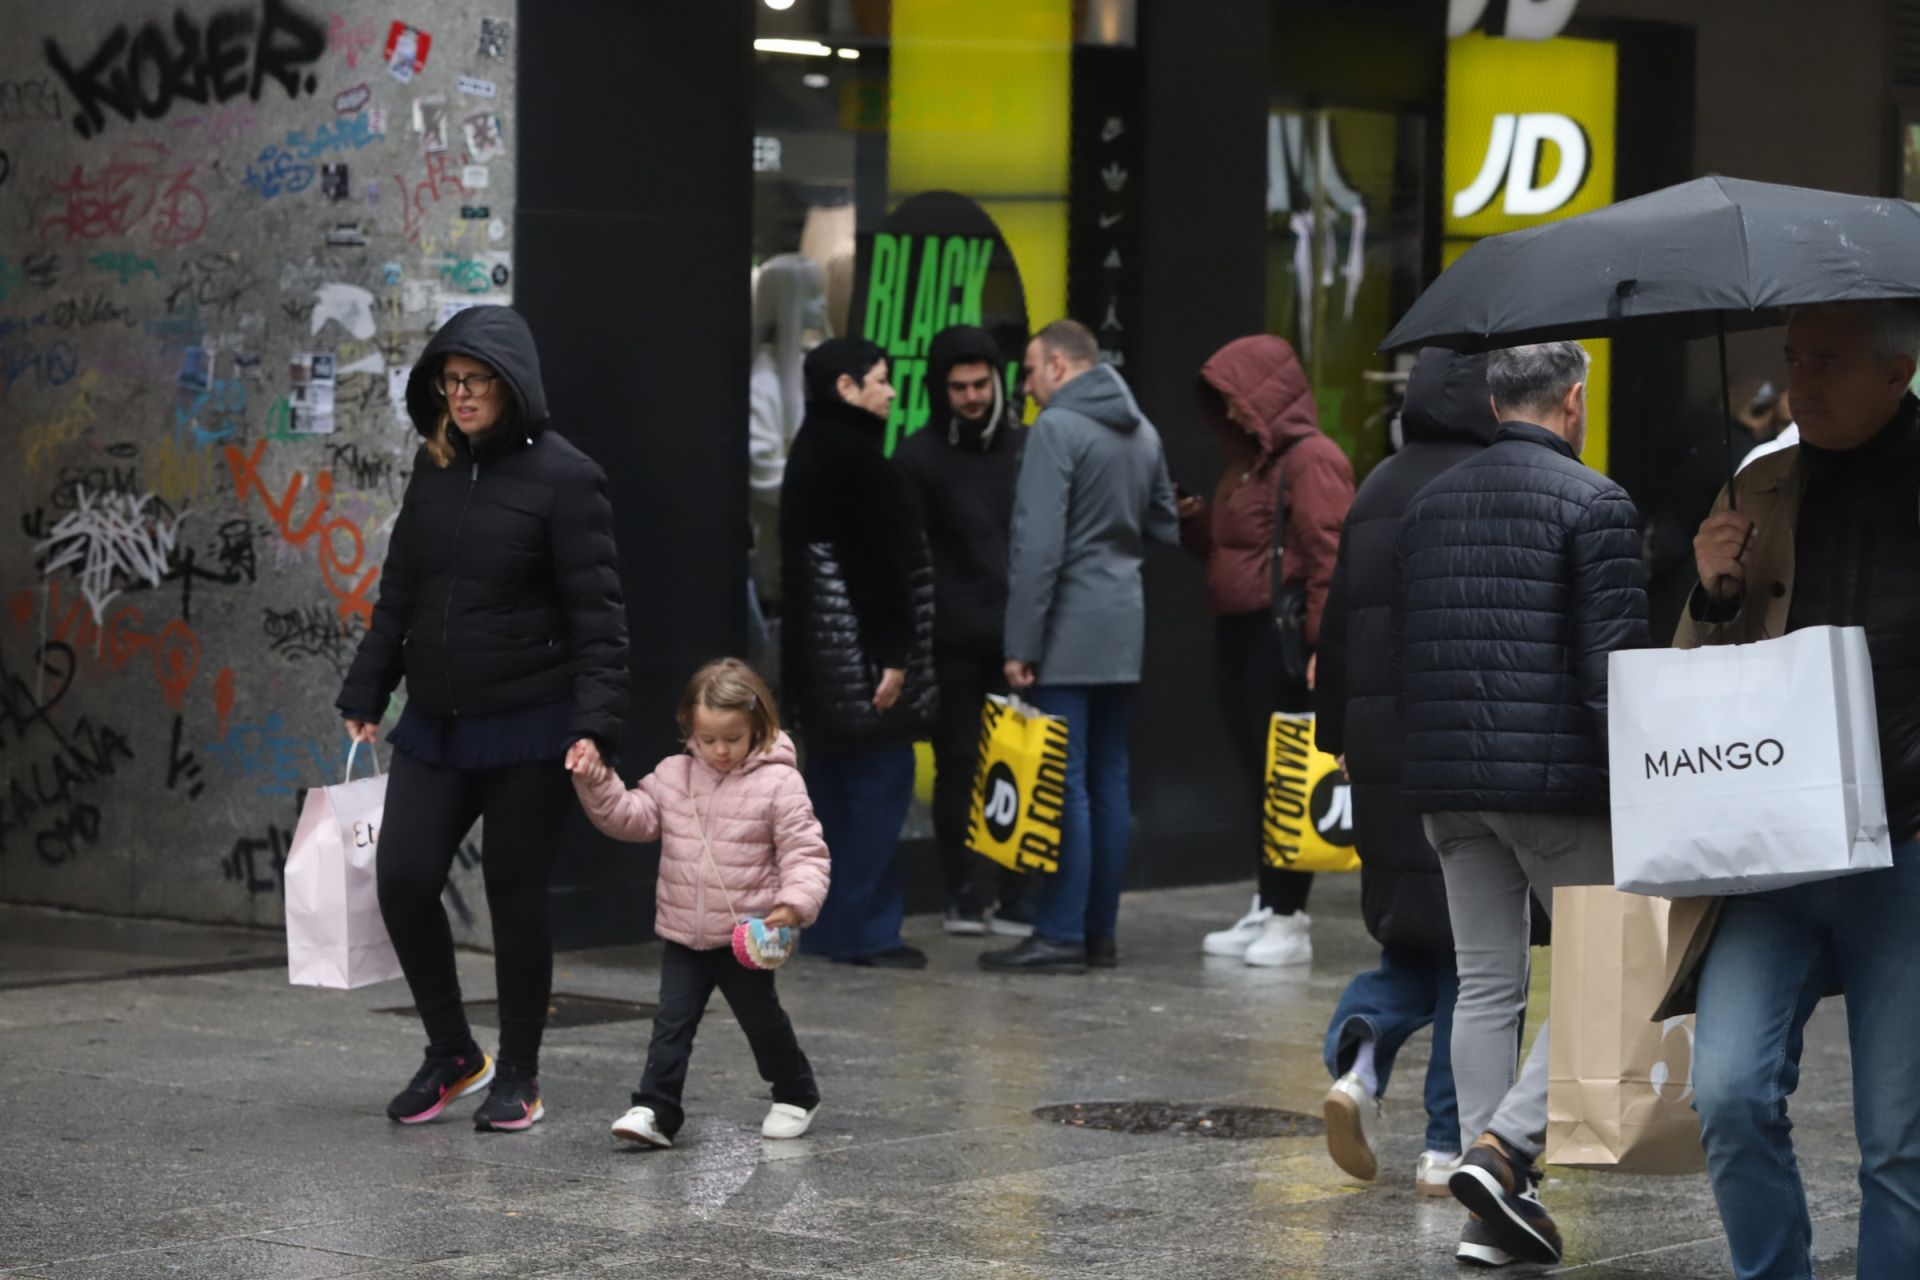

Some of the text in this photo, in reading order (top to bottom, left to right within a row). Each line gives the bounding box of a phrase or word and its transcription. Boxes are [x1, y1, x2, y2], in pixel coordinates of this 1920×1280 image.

[1452, 112, 1587, 218] JD
[863, 232, 994, 357] BLACK
[1645, 738, 1784, 779] MANGO
[984, 778, 1017, 826] JD
